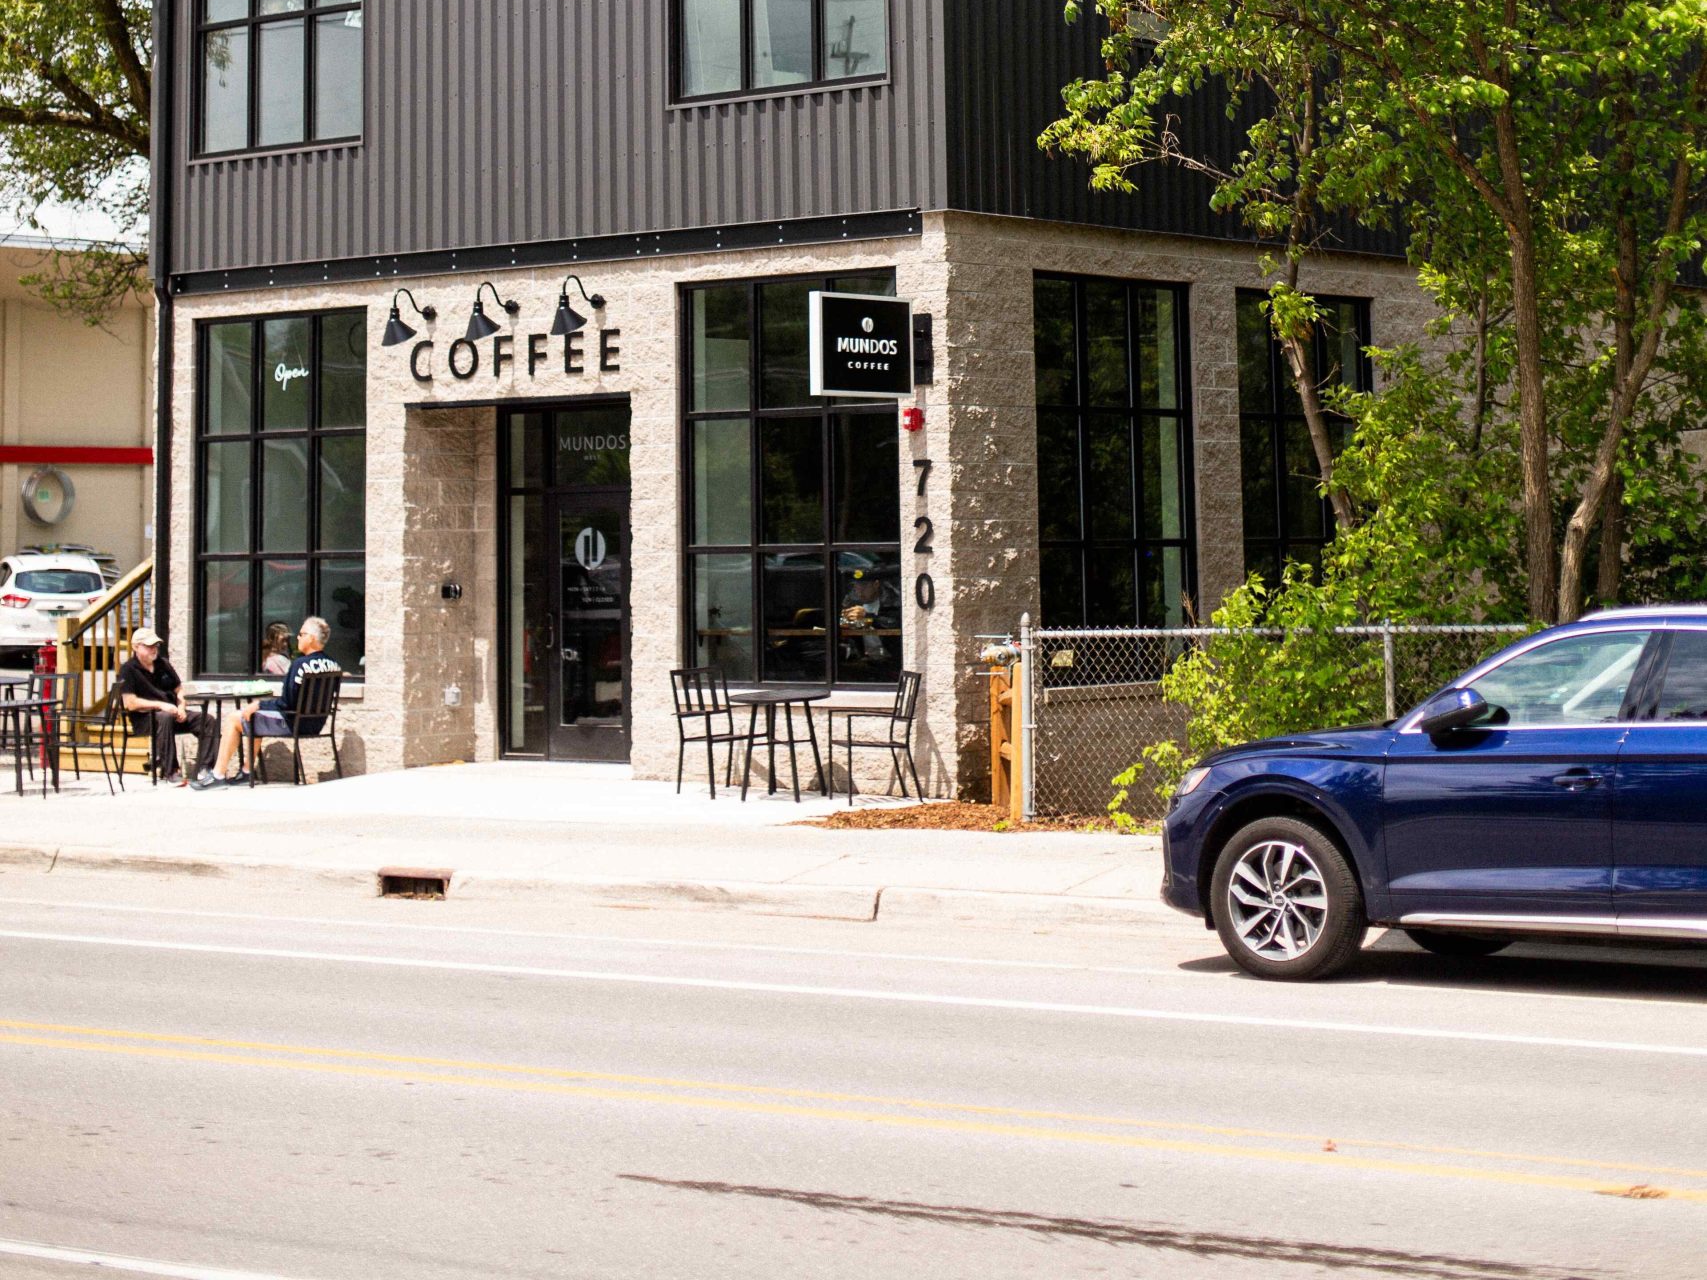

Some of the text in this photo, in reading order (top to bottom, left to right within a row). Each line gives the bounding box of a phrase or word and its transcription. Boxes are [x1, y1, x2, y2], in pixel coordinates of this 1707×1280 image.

[410, 329, 620, 382] COFFEE
[837, 337, 898, 355] MUNDOS
[275, 363, 309, 391] Open
[847, 361, 890, 371] COFFEE
[560, 434, 626, 451] MUNDOS
[912, 459, 935, 610] 720
